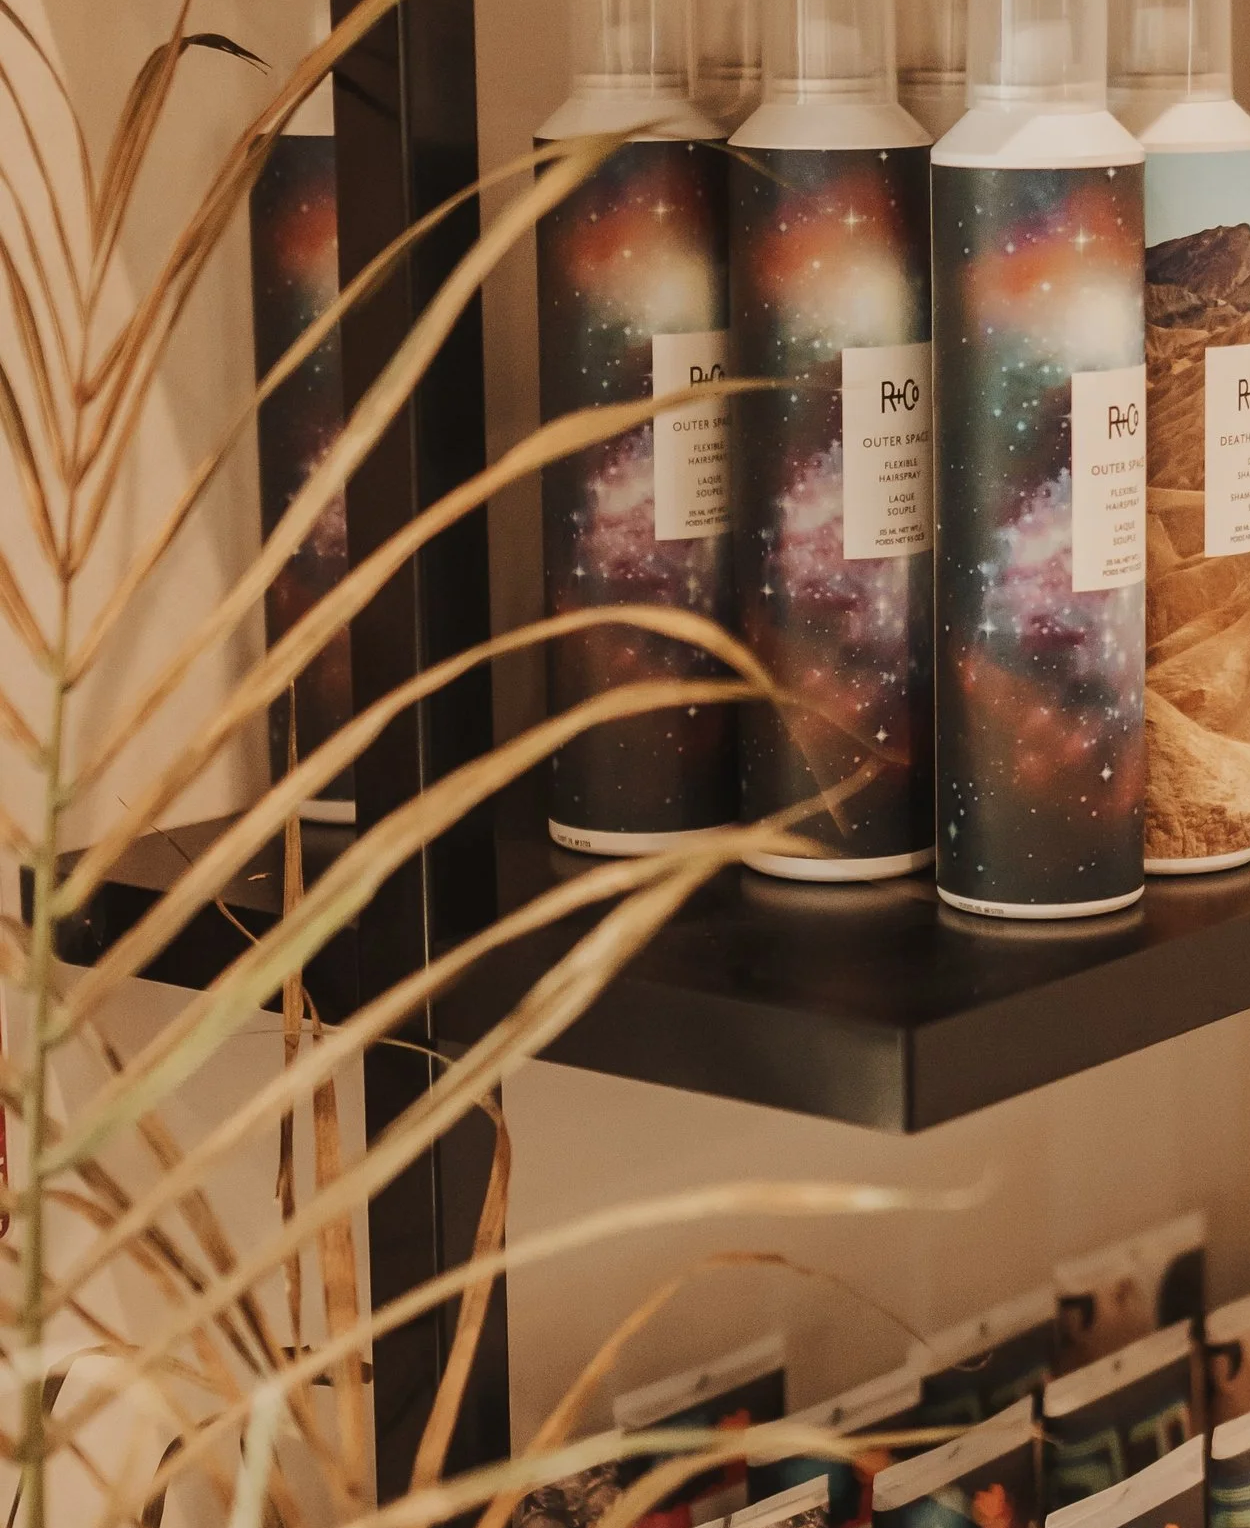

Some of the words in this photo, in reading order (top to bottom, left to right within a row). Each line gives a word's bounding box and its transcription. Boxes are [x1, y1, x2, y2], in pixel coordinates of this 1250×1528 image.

[881, 379, 919, 414] R+Co
[673, 421, 709, 432] OUTER
[1108, 403, 1139, 439] R+Co
[863, 435, 902, 448] OUTER
[884, 457, 919, 469] FLEXIBLE
[1091, 461, 1126, 476] OUTER
[879, 471, 921, 483] HAIRSPRAY
[889, 492, 915, 503] LAQUE
[887, 505, 917, 516] SOUPLE
